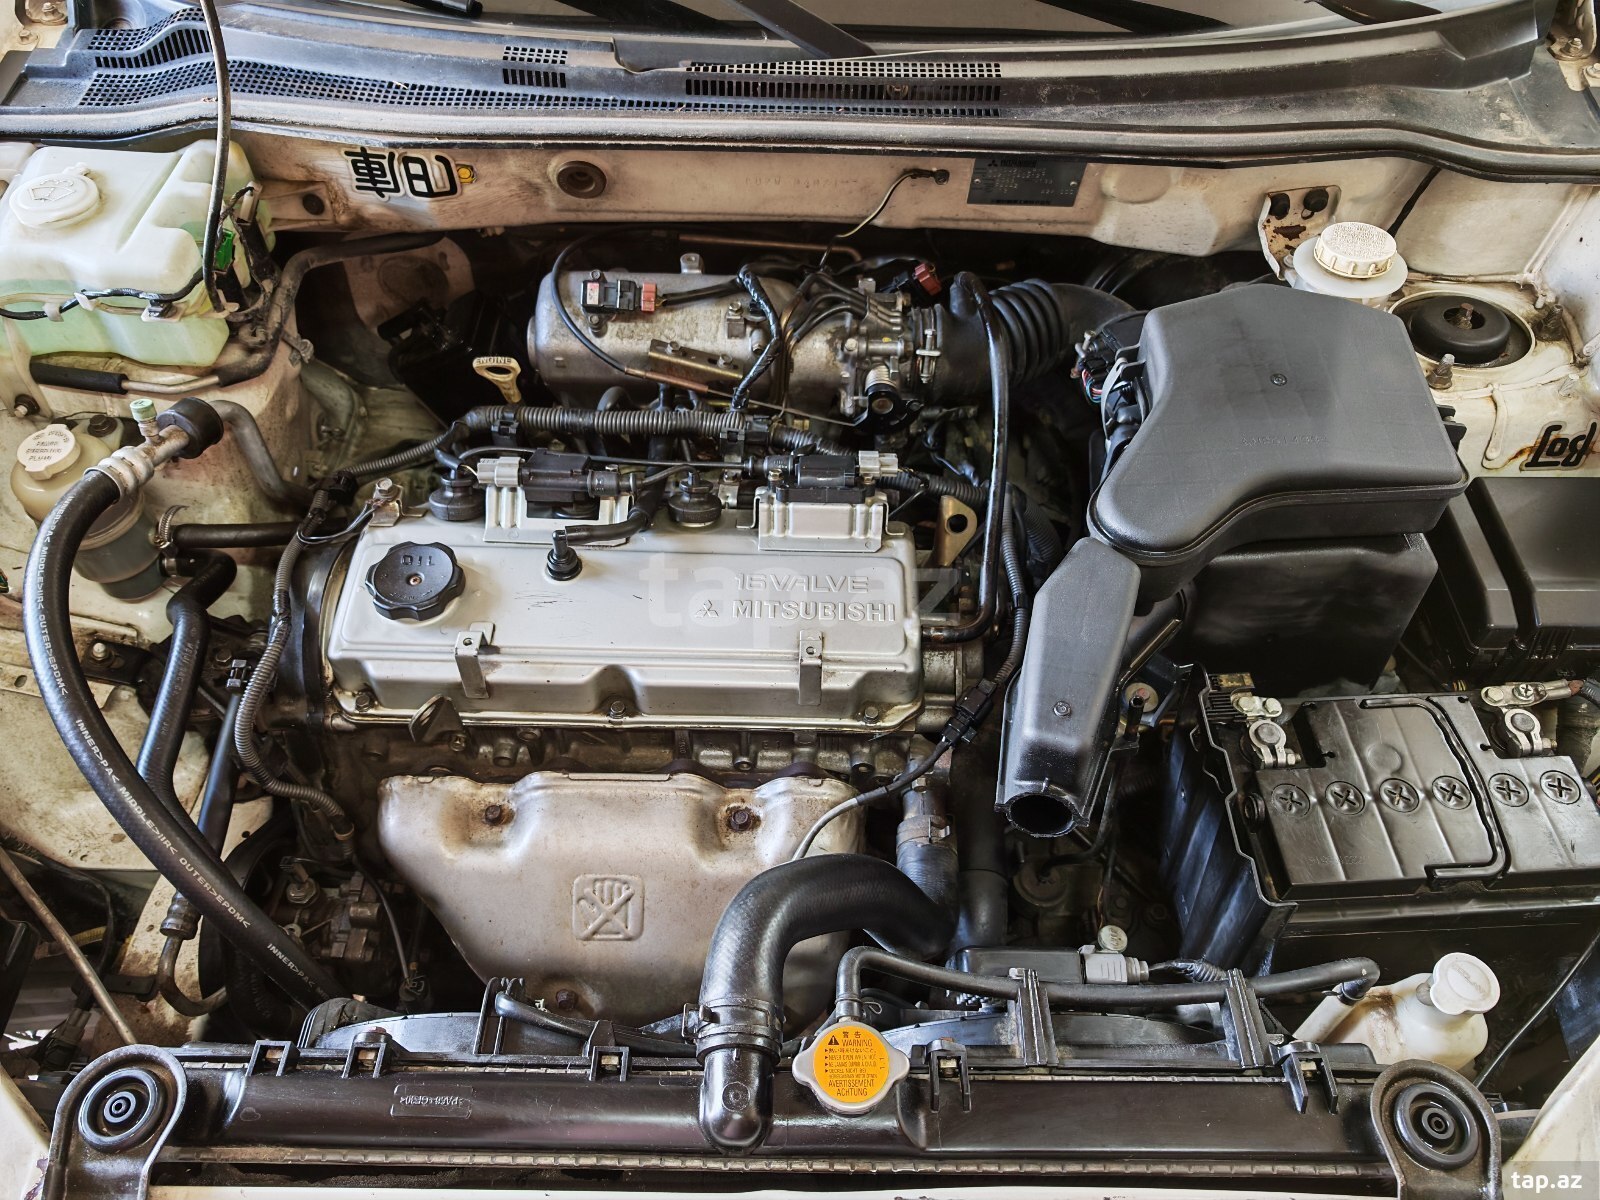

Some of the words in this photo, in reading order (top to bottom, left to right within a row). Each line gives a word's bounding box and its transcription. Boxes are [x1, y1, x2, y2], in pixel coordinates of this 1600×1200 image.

[401, 554, 435, 566] OIL
[732, 600, 896, 622] MITSUBISHI
[842, 1039, 873, 1047] WARNING
[828, 1079, 875, 1087] AVERTISSEMENT
[837, 1088, 868, 1096] ACHTUNG
